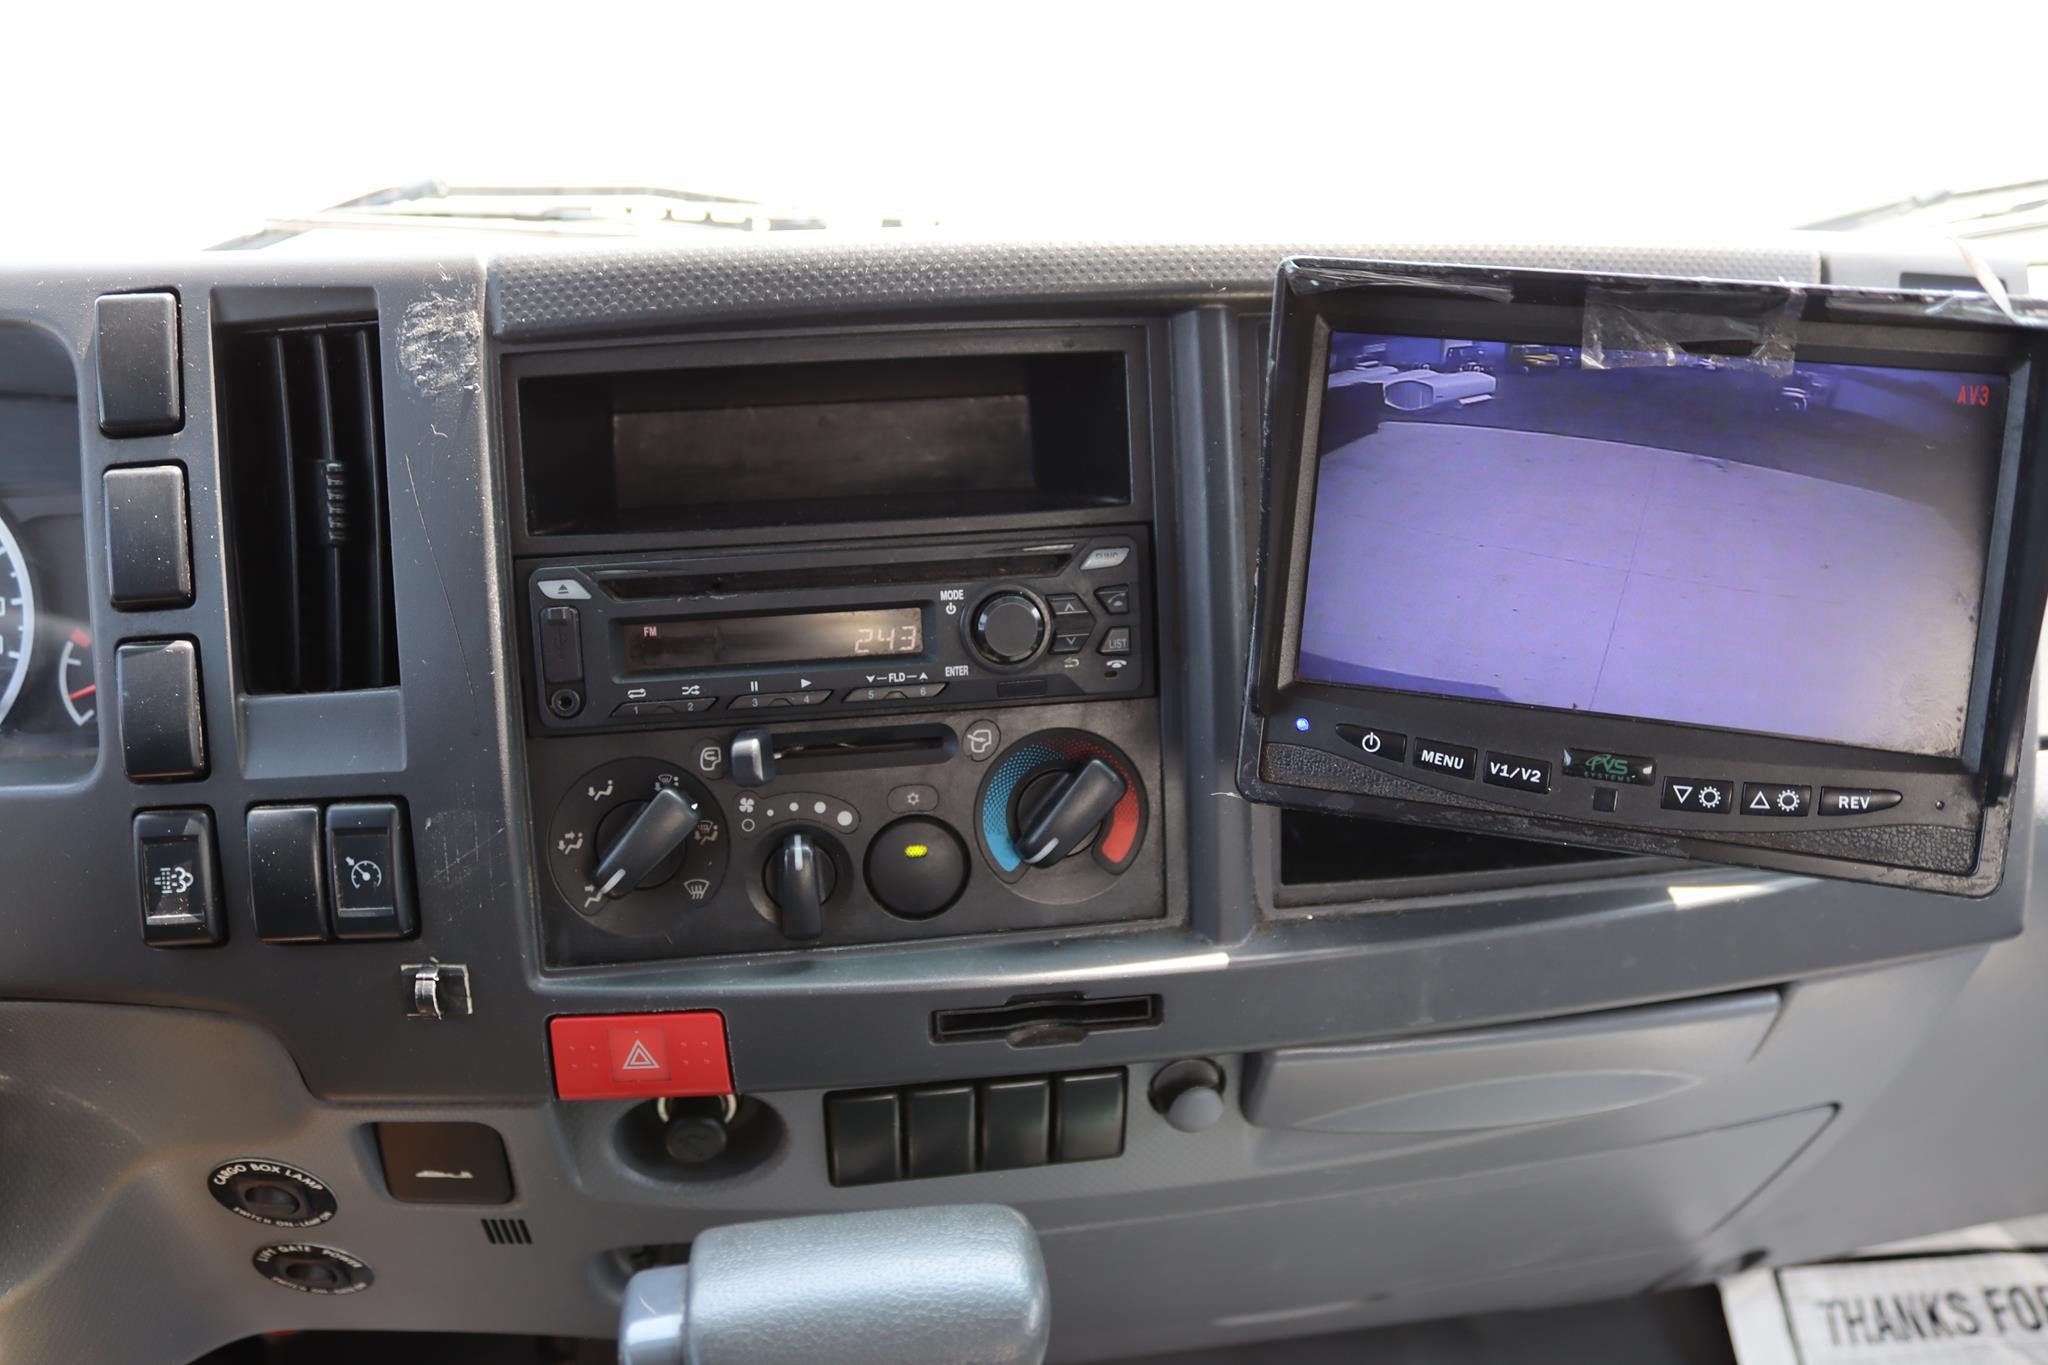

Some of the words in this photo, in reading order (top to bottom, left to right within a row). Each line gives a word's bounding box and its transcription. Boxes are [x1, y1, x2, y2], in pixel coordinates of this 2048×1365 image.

[1956, 383, 1991, 407] AV3
[940, 589, 965, 600] MODE
[643, 626, 657, 638] FM
[854, 625, 917, 653] 243
[1108, 638, 1127, 649] LIST
[945, 665, 969, 677] ENTER
[888, 672, 906, 683] FLD
[868, 690, 875, 699] 5
[919, 687, 926, 696] 6
[751, 698, 759, 707] 3
[803, 695, 810, 704] 4
[633, 705, 639, 714] 1
[687, 702, 694, 711] 2
[1420, 749, 1465, 770] MENU
[1490, 761, 1541, 783] V1/V2
[1838, 795, 1870, 809] REV
[213, 1164, 247, 1185] CARGO
[249, 1163, 281, 1174] BOX
[285, 1169, 323, 1190] LAMP
[1816, 1290, 1980, 1346] THANKS
